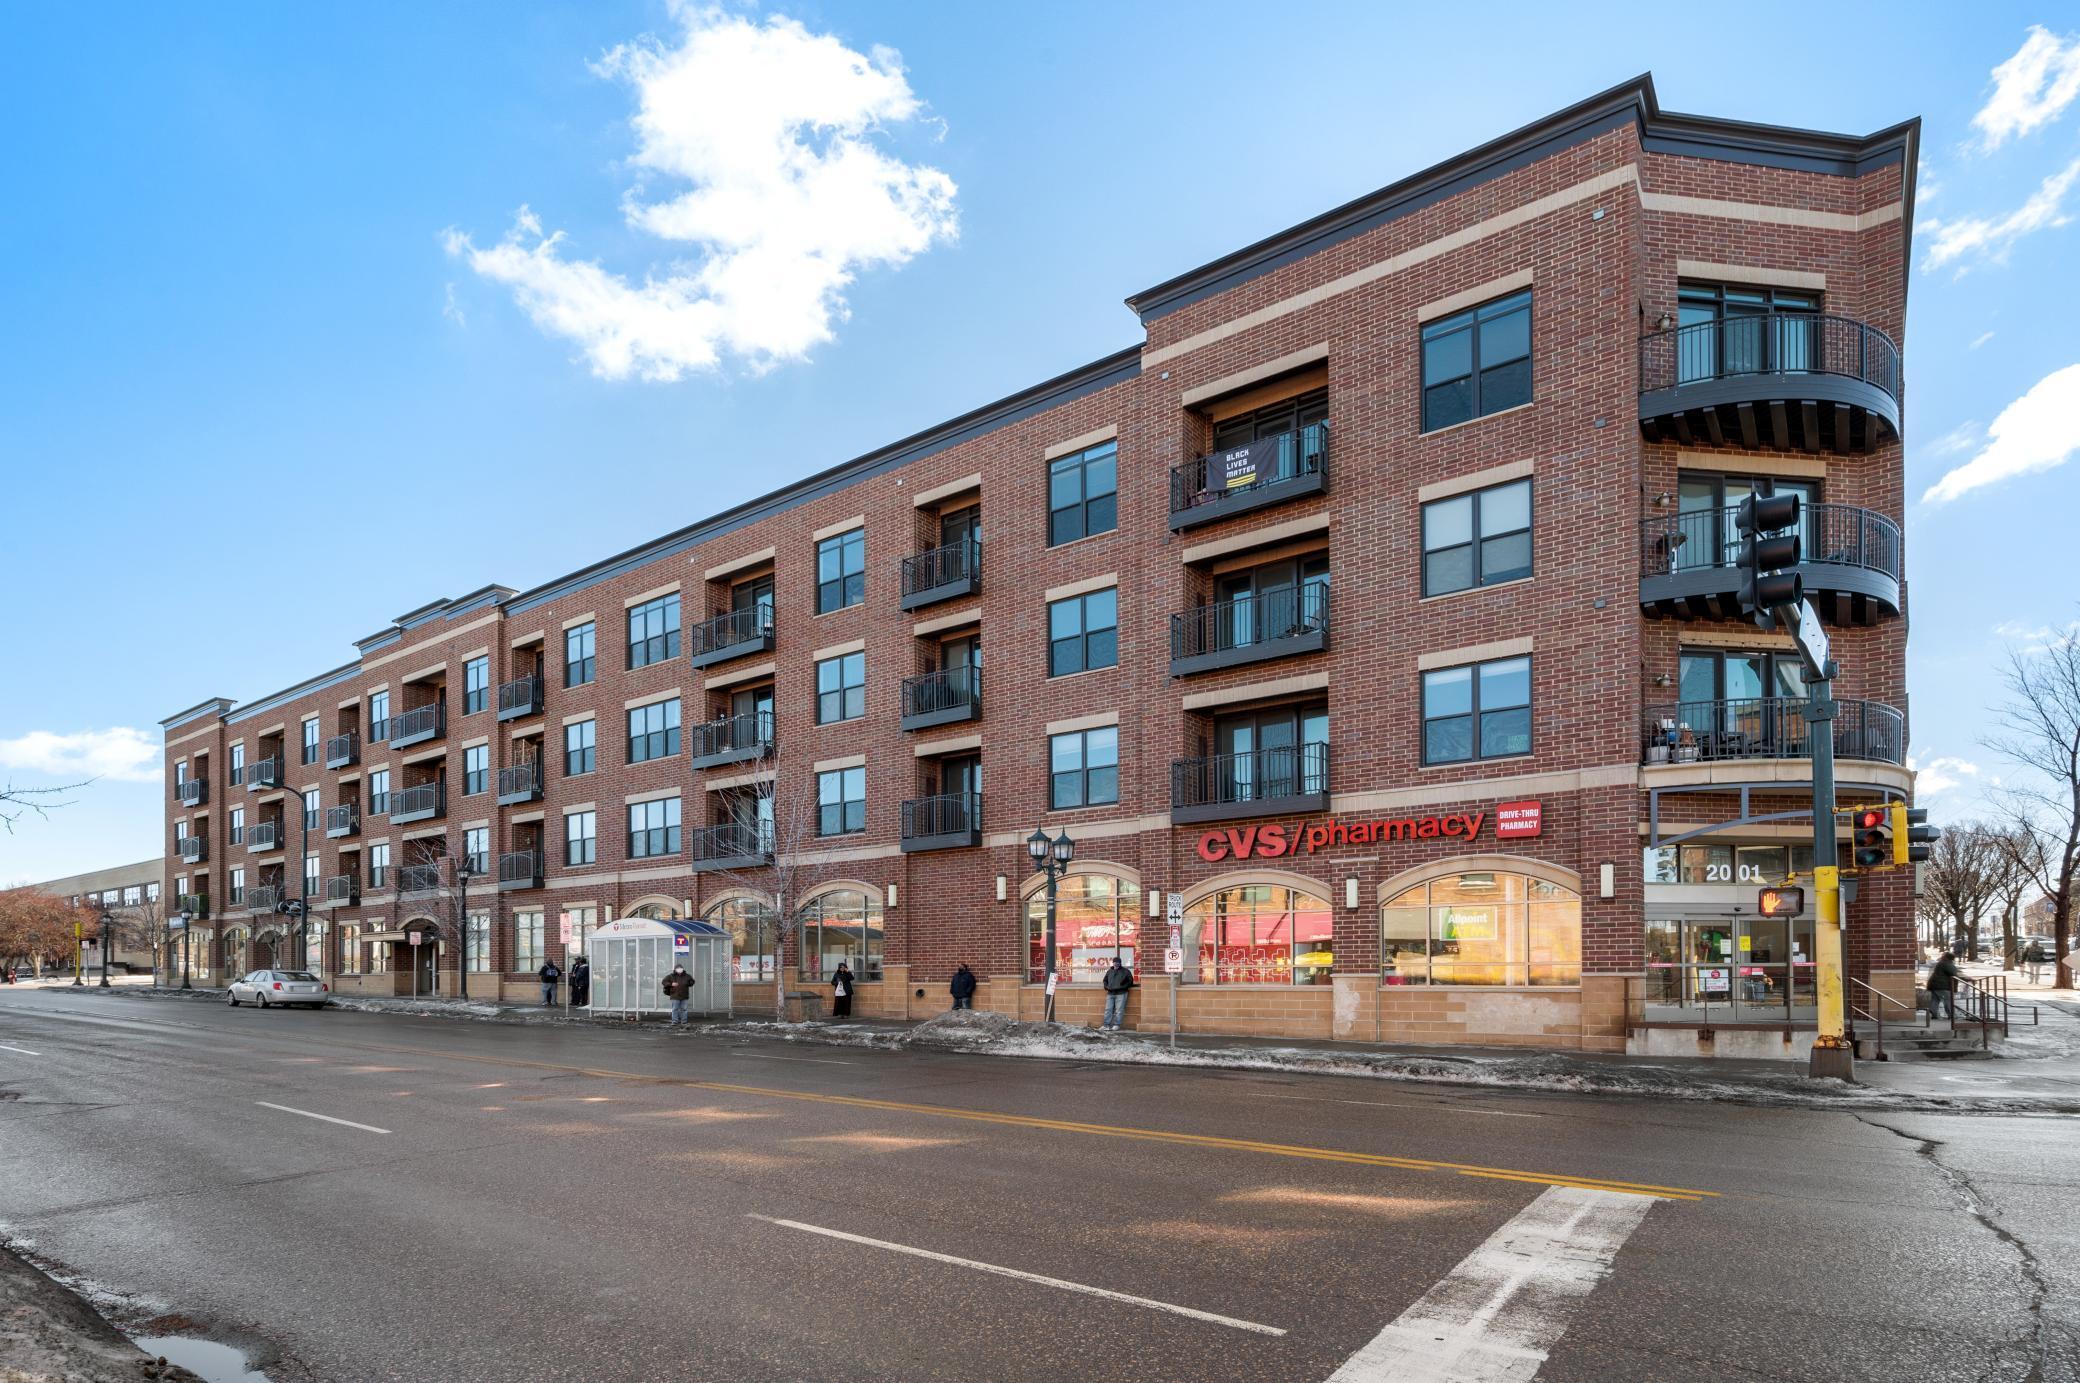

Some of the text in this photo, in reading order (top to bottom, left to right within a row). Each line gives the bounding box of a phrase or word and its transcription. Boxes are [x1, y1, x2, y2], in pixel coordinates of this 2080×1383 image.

[1226, 449, 1249, 461] BLACK
[1226, 458, 1248, 470] LIVES
[1226, 463, 1256, 478] MATTER
[1499, 809, 1539, 819] DRIVE-THRU
[1500, 820, 1538, 831] PHARMACY
[1706, 864, 1760, 881] 2001
[1168, 901, 1182, 909] ROUTE
[1448, 912, 1488, 925] Allpoint
